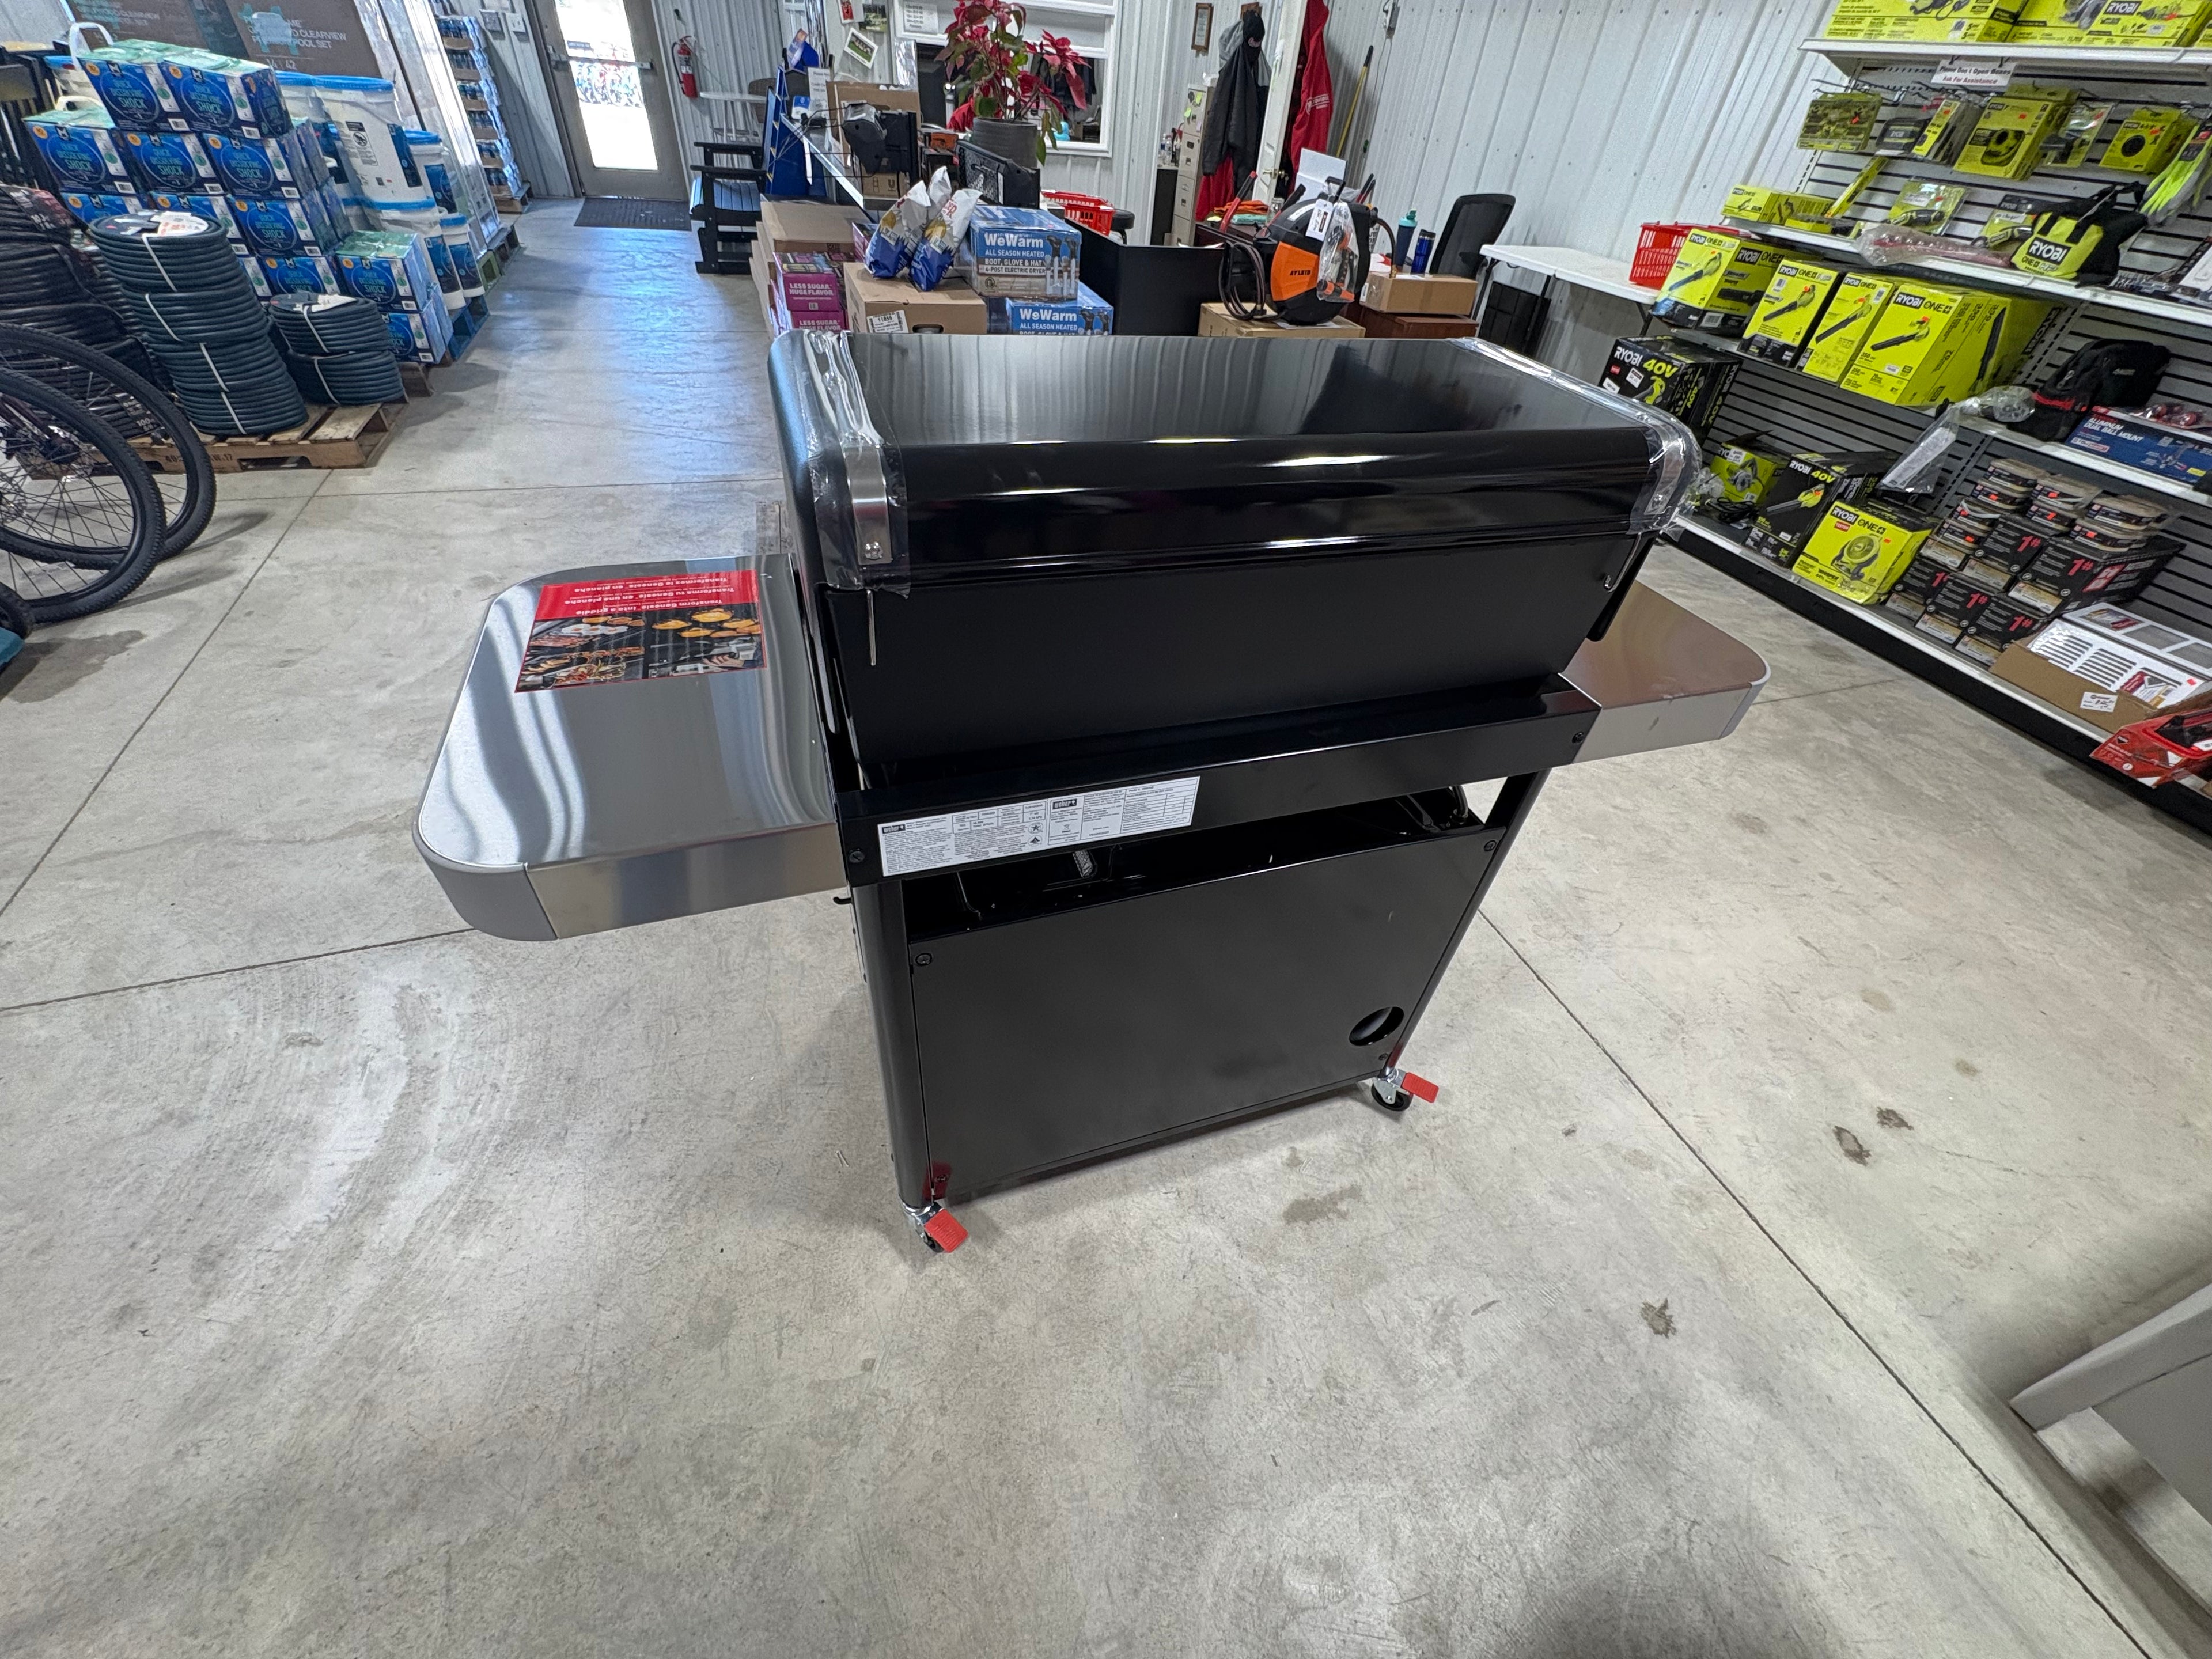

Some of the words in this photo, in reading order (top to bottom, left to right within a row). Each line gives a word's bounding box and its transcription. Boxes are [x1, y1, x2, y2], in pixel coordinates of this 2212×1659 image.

[2107, 2, 2137, 13] RYOBI
[300, 29, 347, 41] CLEARVIEW
[316, 39, 332, 48] SET
[118, 97, 148, 109] SHOCK
[195, 101, 224, 115] SHOCK
[64, 159, 94, 171] SHOCK
[157, 165, 185, 176] SHOCK
[236, 168, 264, 179] SHOCK
[262, 229, 286, 239] SHOCK
[1690, 234, 1706, 244] RYOBI
[984, 232, 1044, 248] WeWarm
[997, 249, 1020, 257] SEASON
[1737, 248, 1761, 263] RYOBI
[2028, 240, 2067, 262] RYOBI
[984, 258, 1003, 266] BOOT,
[1779, 266, 1797, 276] RYOBI
[1844, 278, 1860, 287] RYOBI
[363, 285, 387, 294] SHOCK
[1895, 294, 1923, 308] RYOBI
[1020, 308, 1077, 322] WeWarm
[1613, 346, 1643, 367] RYOBI
[1642, 358, 1679, 379] 40V
[2087, 417, 2125, 431] ALUMINUM
[2083, 421, 2102, 431] DUAL
[2100, 426, 2119, 436] BALL
[2116, 431, 2145, 443] MOUNT
[1789, 460, 1811, 475] RYOBI
[1810, 470, 1836, 484] 40V
[1832, 507, 1857, 524] RYOBI
[2017, 536, 2041, 552] 1#
[2067, 558, 2094, 576] 1#
[675, 577, 728, 586] Transformez
[574, 585, 611, 594] plancha
[687, 586, 735, 596] Transforma
[564, 596, 603, 605] plancha
[679, 599, 723, 607] Transform
[1965, 593, 1988, 609] 1#
[575, 607, 609, 616] griddle
[2008, 615, 2033, 632] 1#
[1053, 799, 1071, 809] weber
[883, 824, 900, 834] weber
